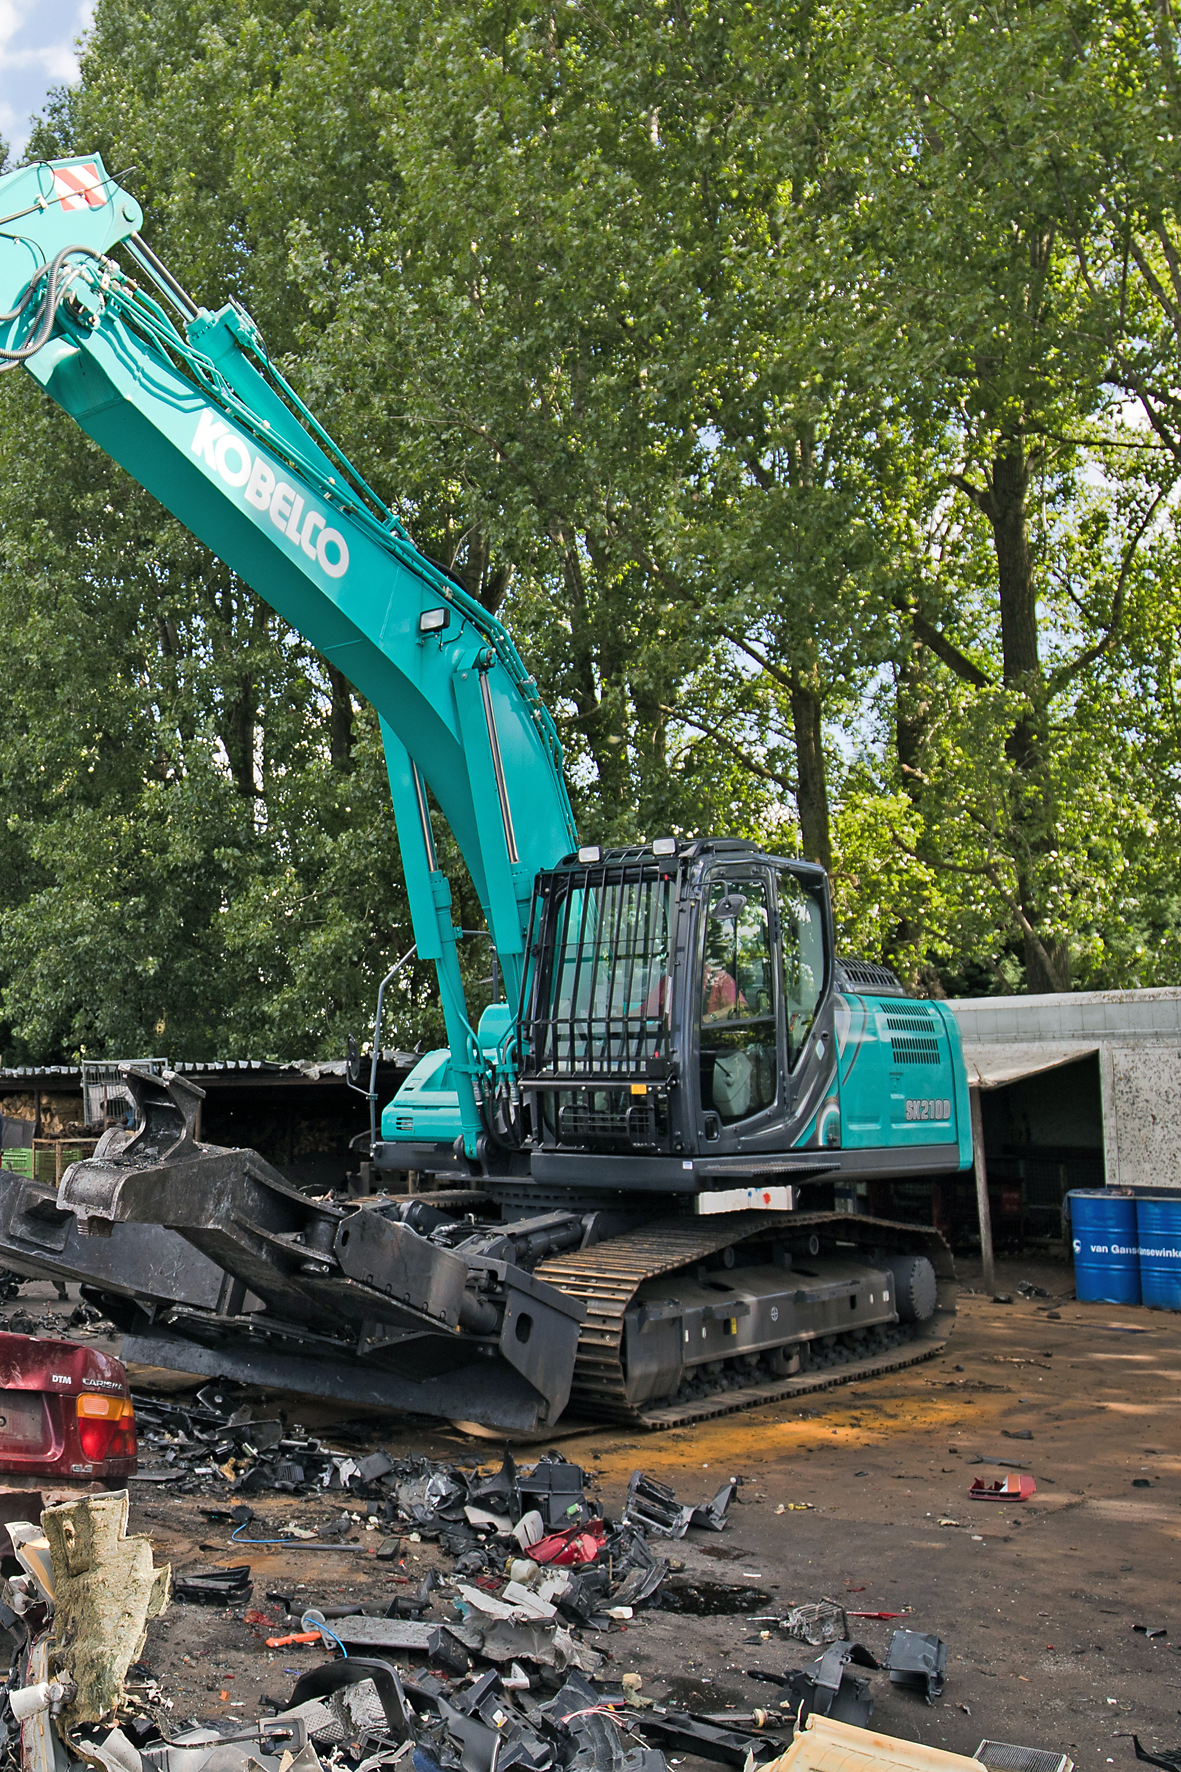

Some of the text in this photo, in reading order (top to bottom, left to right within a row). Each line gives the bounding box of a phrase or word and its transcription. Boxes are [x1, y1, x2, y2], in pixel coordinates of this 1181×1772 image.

[190, 407, 350, 579] KOBELCO
[905, 1098, 952, 1121] SK210D
[1090, 1244, 1108, 1254] van
[52, 1374, 124, 1390] DTM CARISMA
